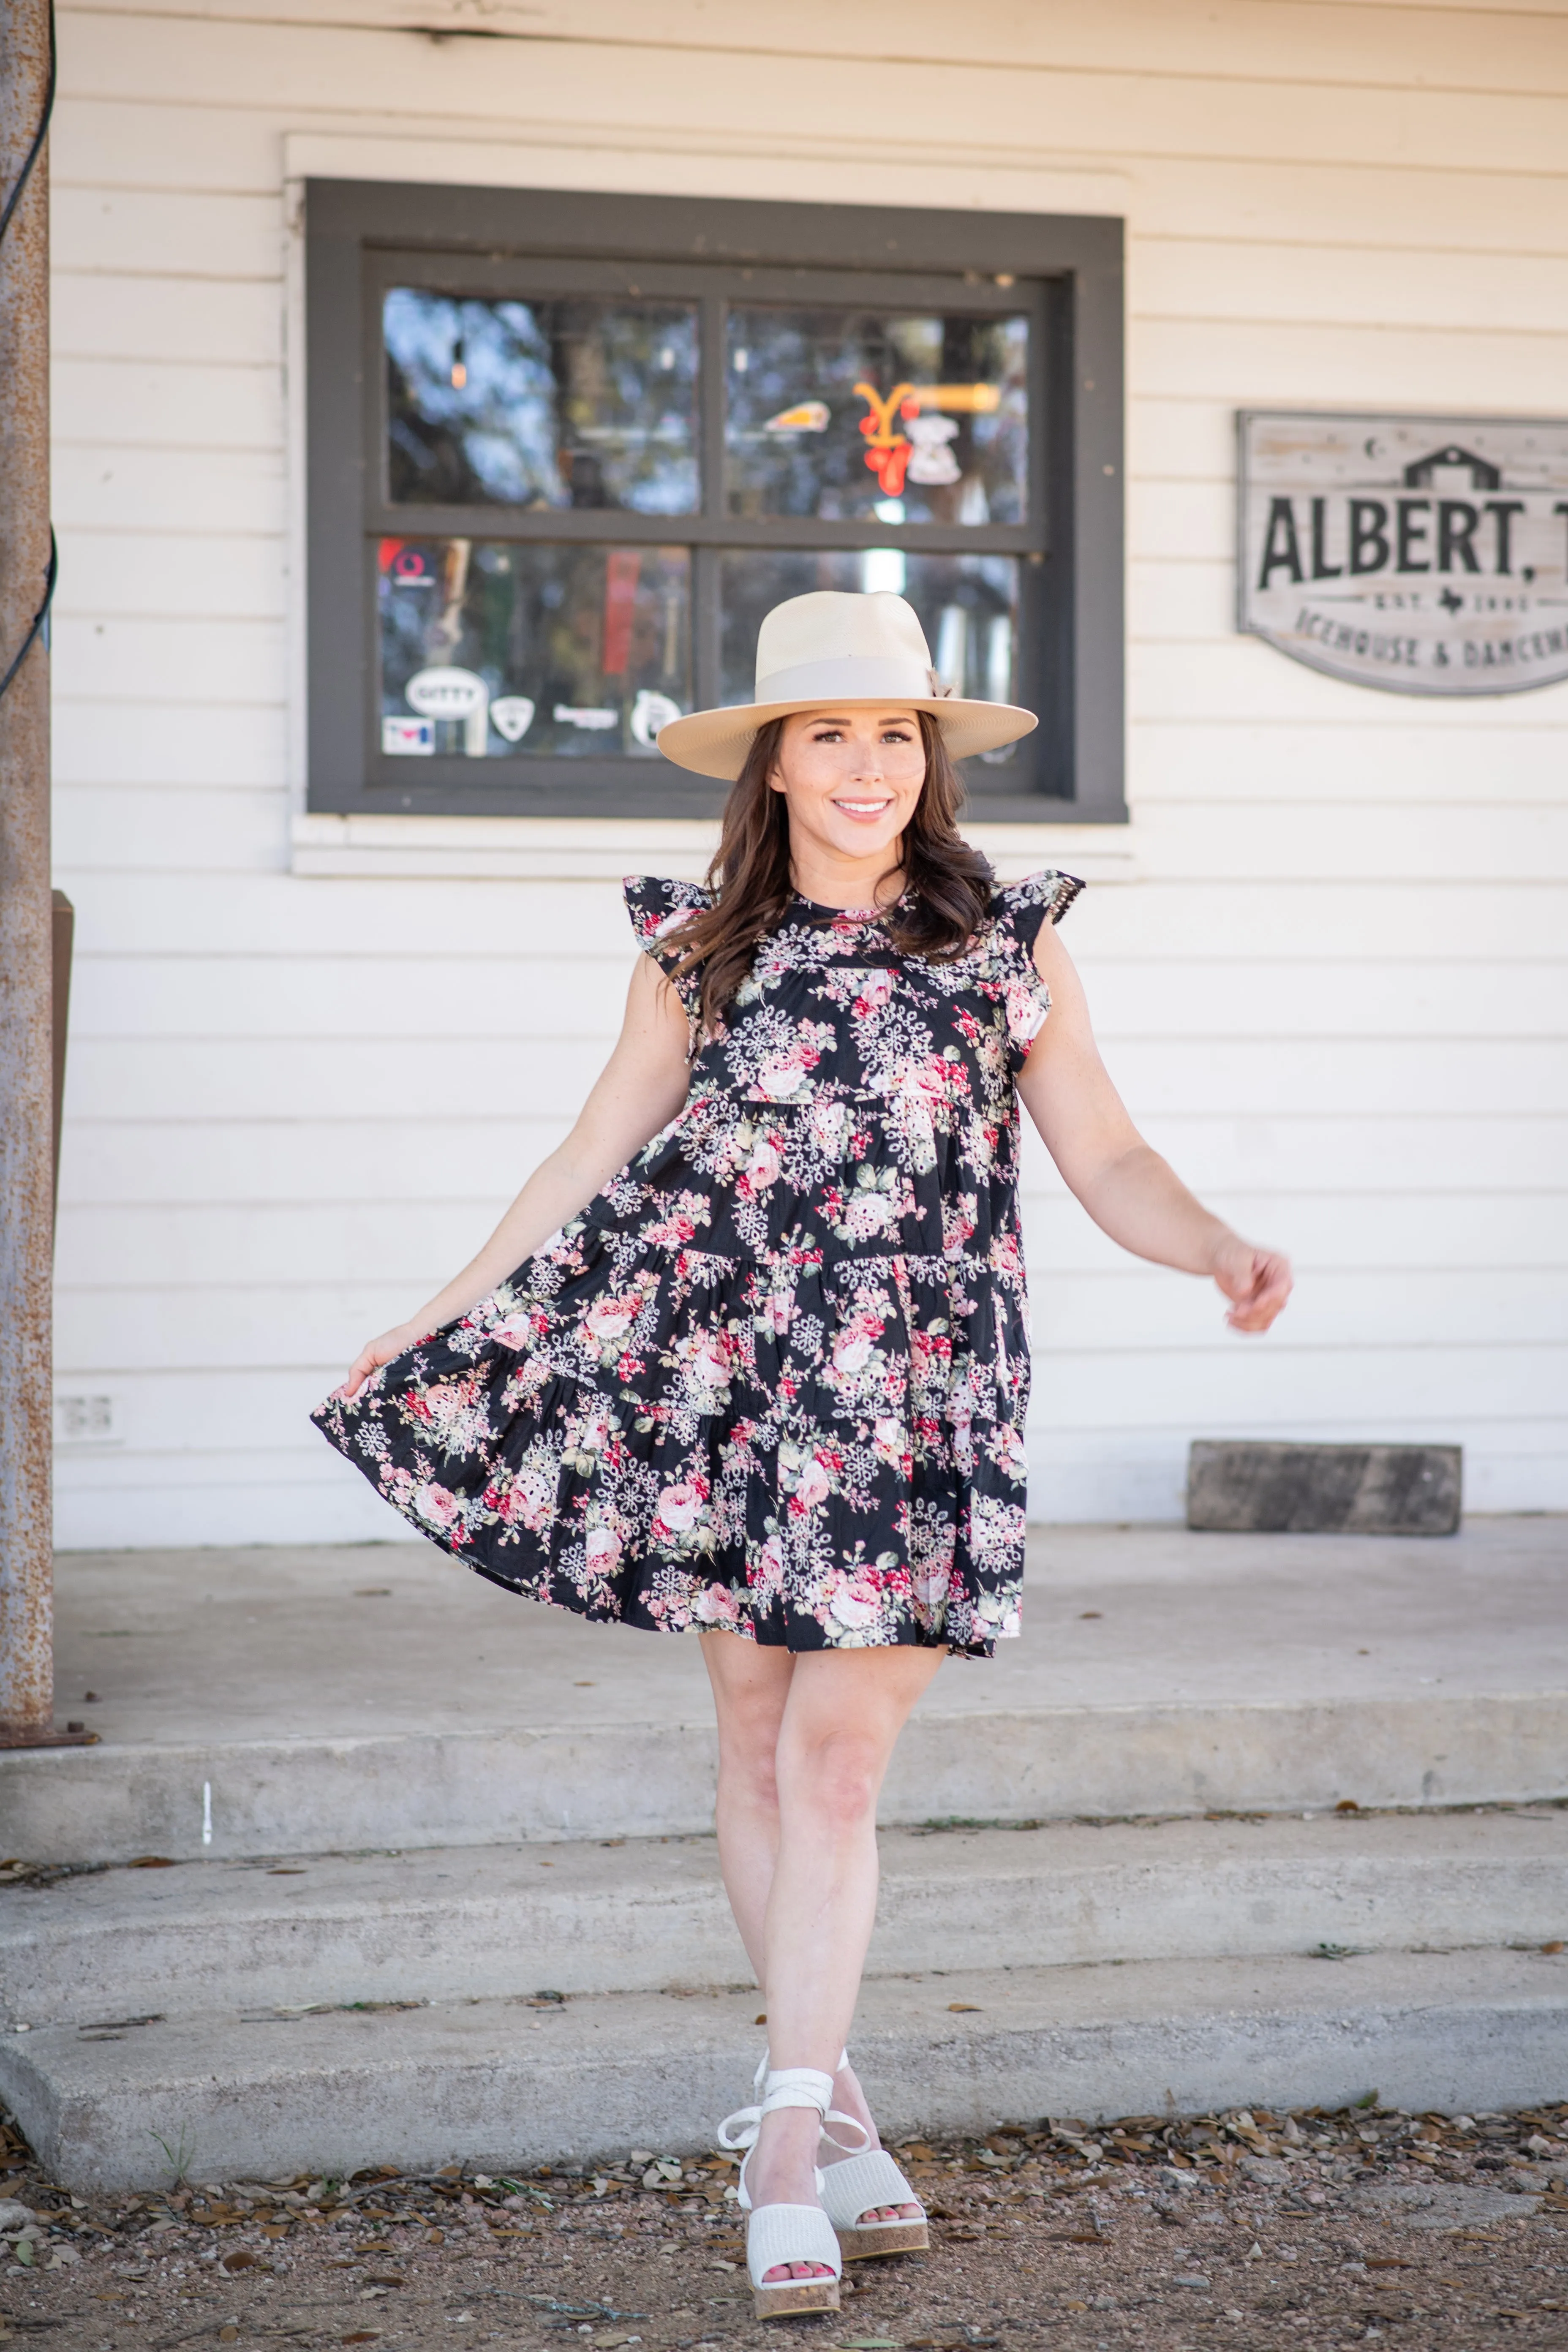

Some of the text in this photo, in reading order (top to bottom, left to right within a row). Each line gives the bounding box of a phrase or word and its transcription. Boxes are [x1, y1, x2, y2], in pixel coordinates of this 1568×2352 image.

[1294, 606, 1568, 668] ICEHOUSE & DANCEH
